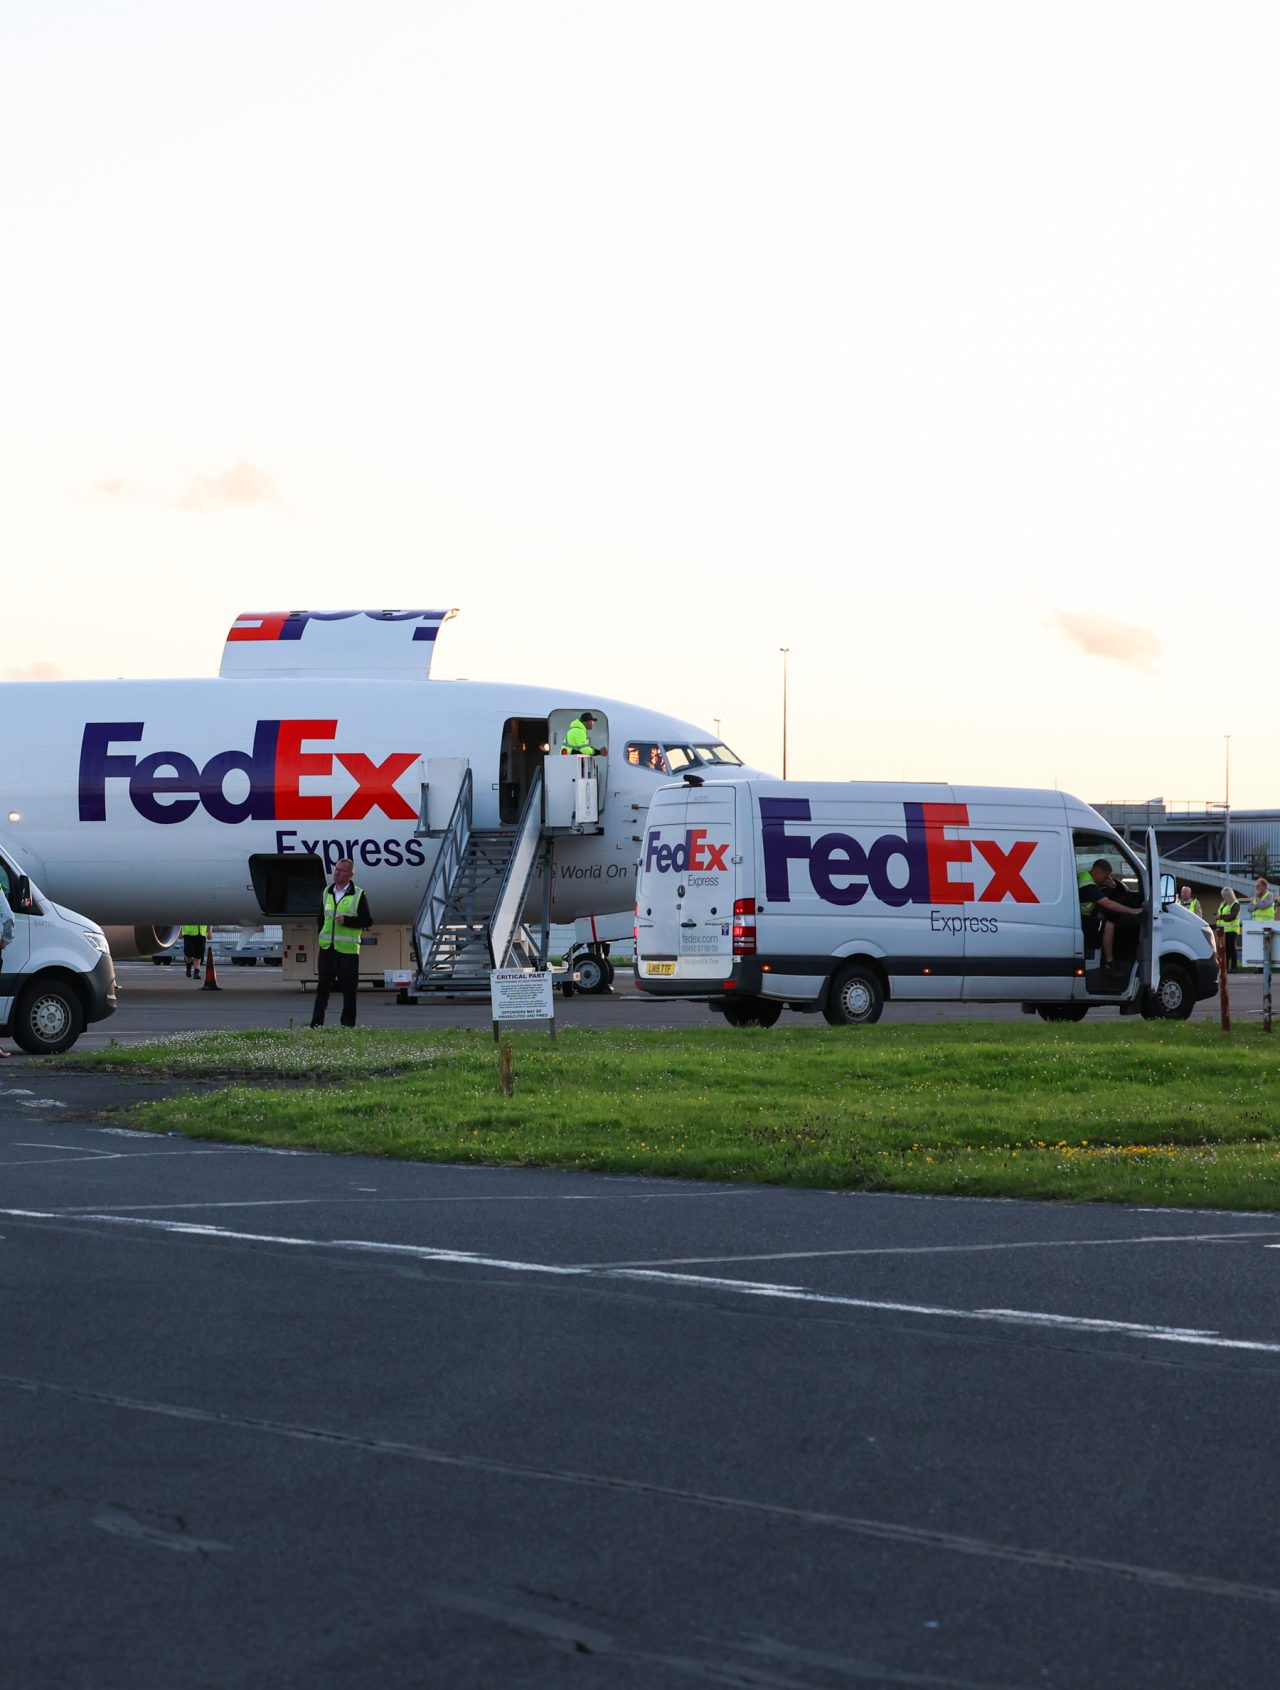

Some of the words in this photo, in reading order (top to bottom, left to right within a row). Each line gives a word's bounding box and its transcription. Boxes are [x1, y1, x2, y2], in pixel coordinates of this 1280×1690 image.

[78, 719, 423, 825] FedEx
[645, 829, 730, 874] FedEx
[759, 796, 1041, 908] FedEx
[561, 864, 602, 879] World
[606, 864, 627, 878] On
[687, 874, 720, 888] Express
[930, 910, 998, 936] Express
[682, 932, 719, 943] fedex.com
[661, 964, 672, 973] TTF
